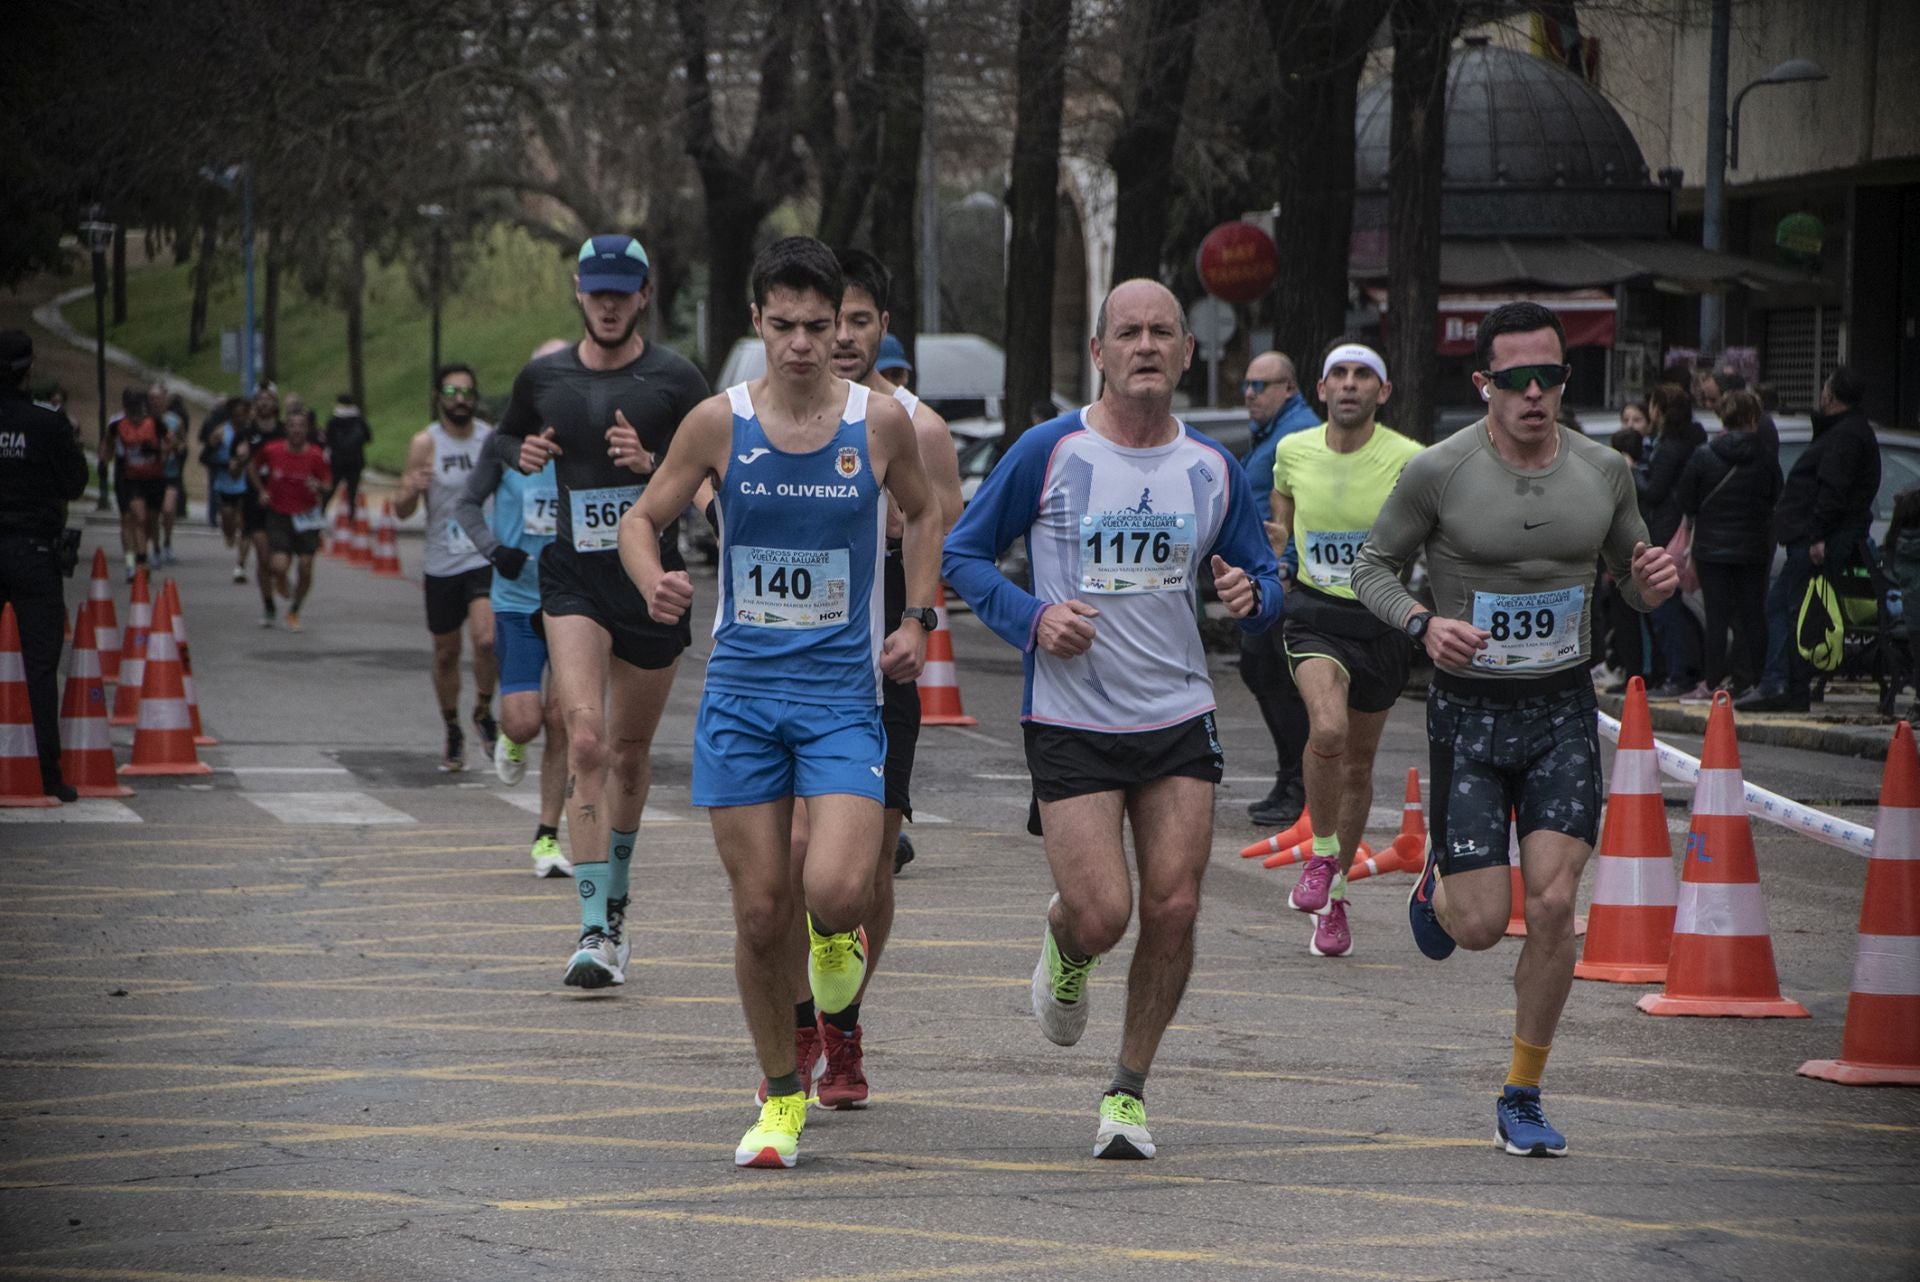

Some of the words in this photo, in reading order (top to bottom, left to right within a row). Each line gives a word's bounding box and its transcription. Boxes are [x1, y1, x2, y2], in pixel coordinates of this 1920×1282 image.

[0, 432, 26, 448] CIA
[0, 448, 24, 458] OCAL
[740, 481, 772, 496] C.A.
[777, 483, 860, 498] OLIVENZA
[1102, 520, 1129, 528] VUELTA
[1131, 520, 1141, 528] AL
[1142, 520, 1177, 528] BALUARTE
[765, 549, 791, 557] CROSS
[1087, 531, 1171, 564] 1176
[751, 553, 779, 563] VUELTA
[780, 555, 790, 563] AL
[791, 556, 830, 564] BALUARTE
[748, 564, 812, 600] 140
[1163, 576, 1183, 585] HOY
[1496, 599, 1524, 608] VUELTA
[820, 611, 843, 621] HOY
[1491, 608, 1555, 641] 839
[1558, 644, 1575, 656] HOY
[1686, 831, 1713, 863] PL
